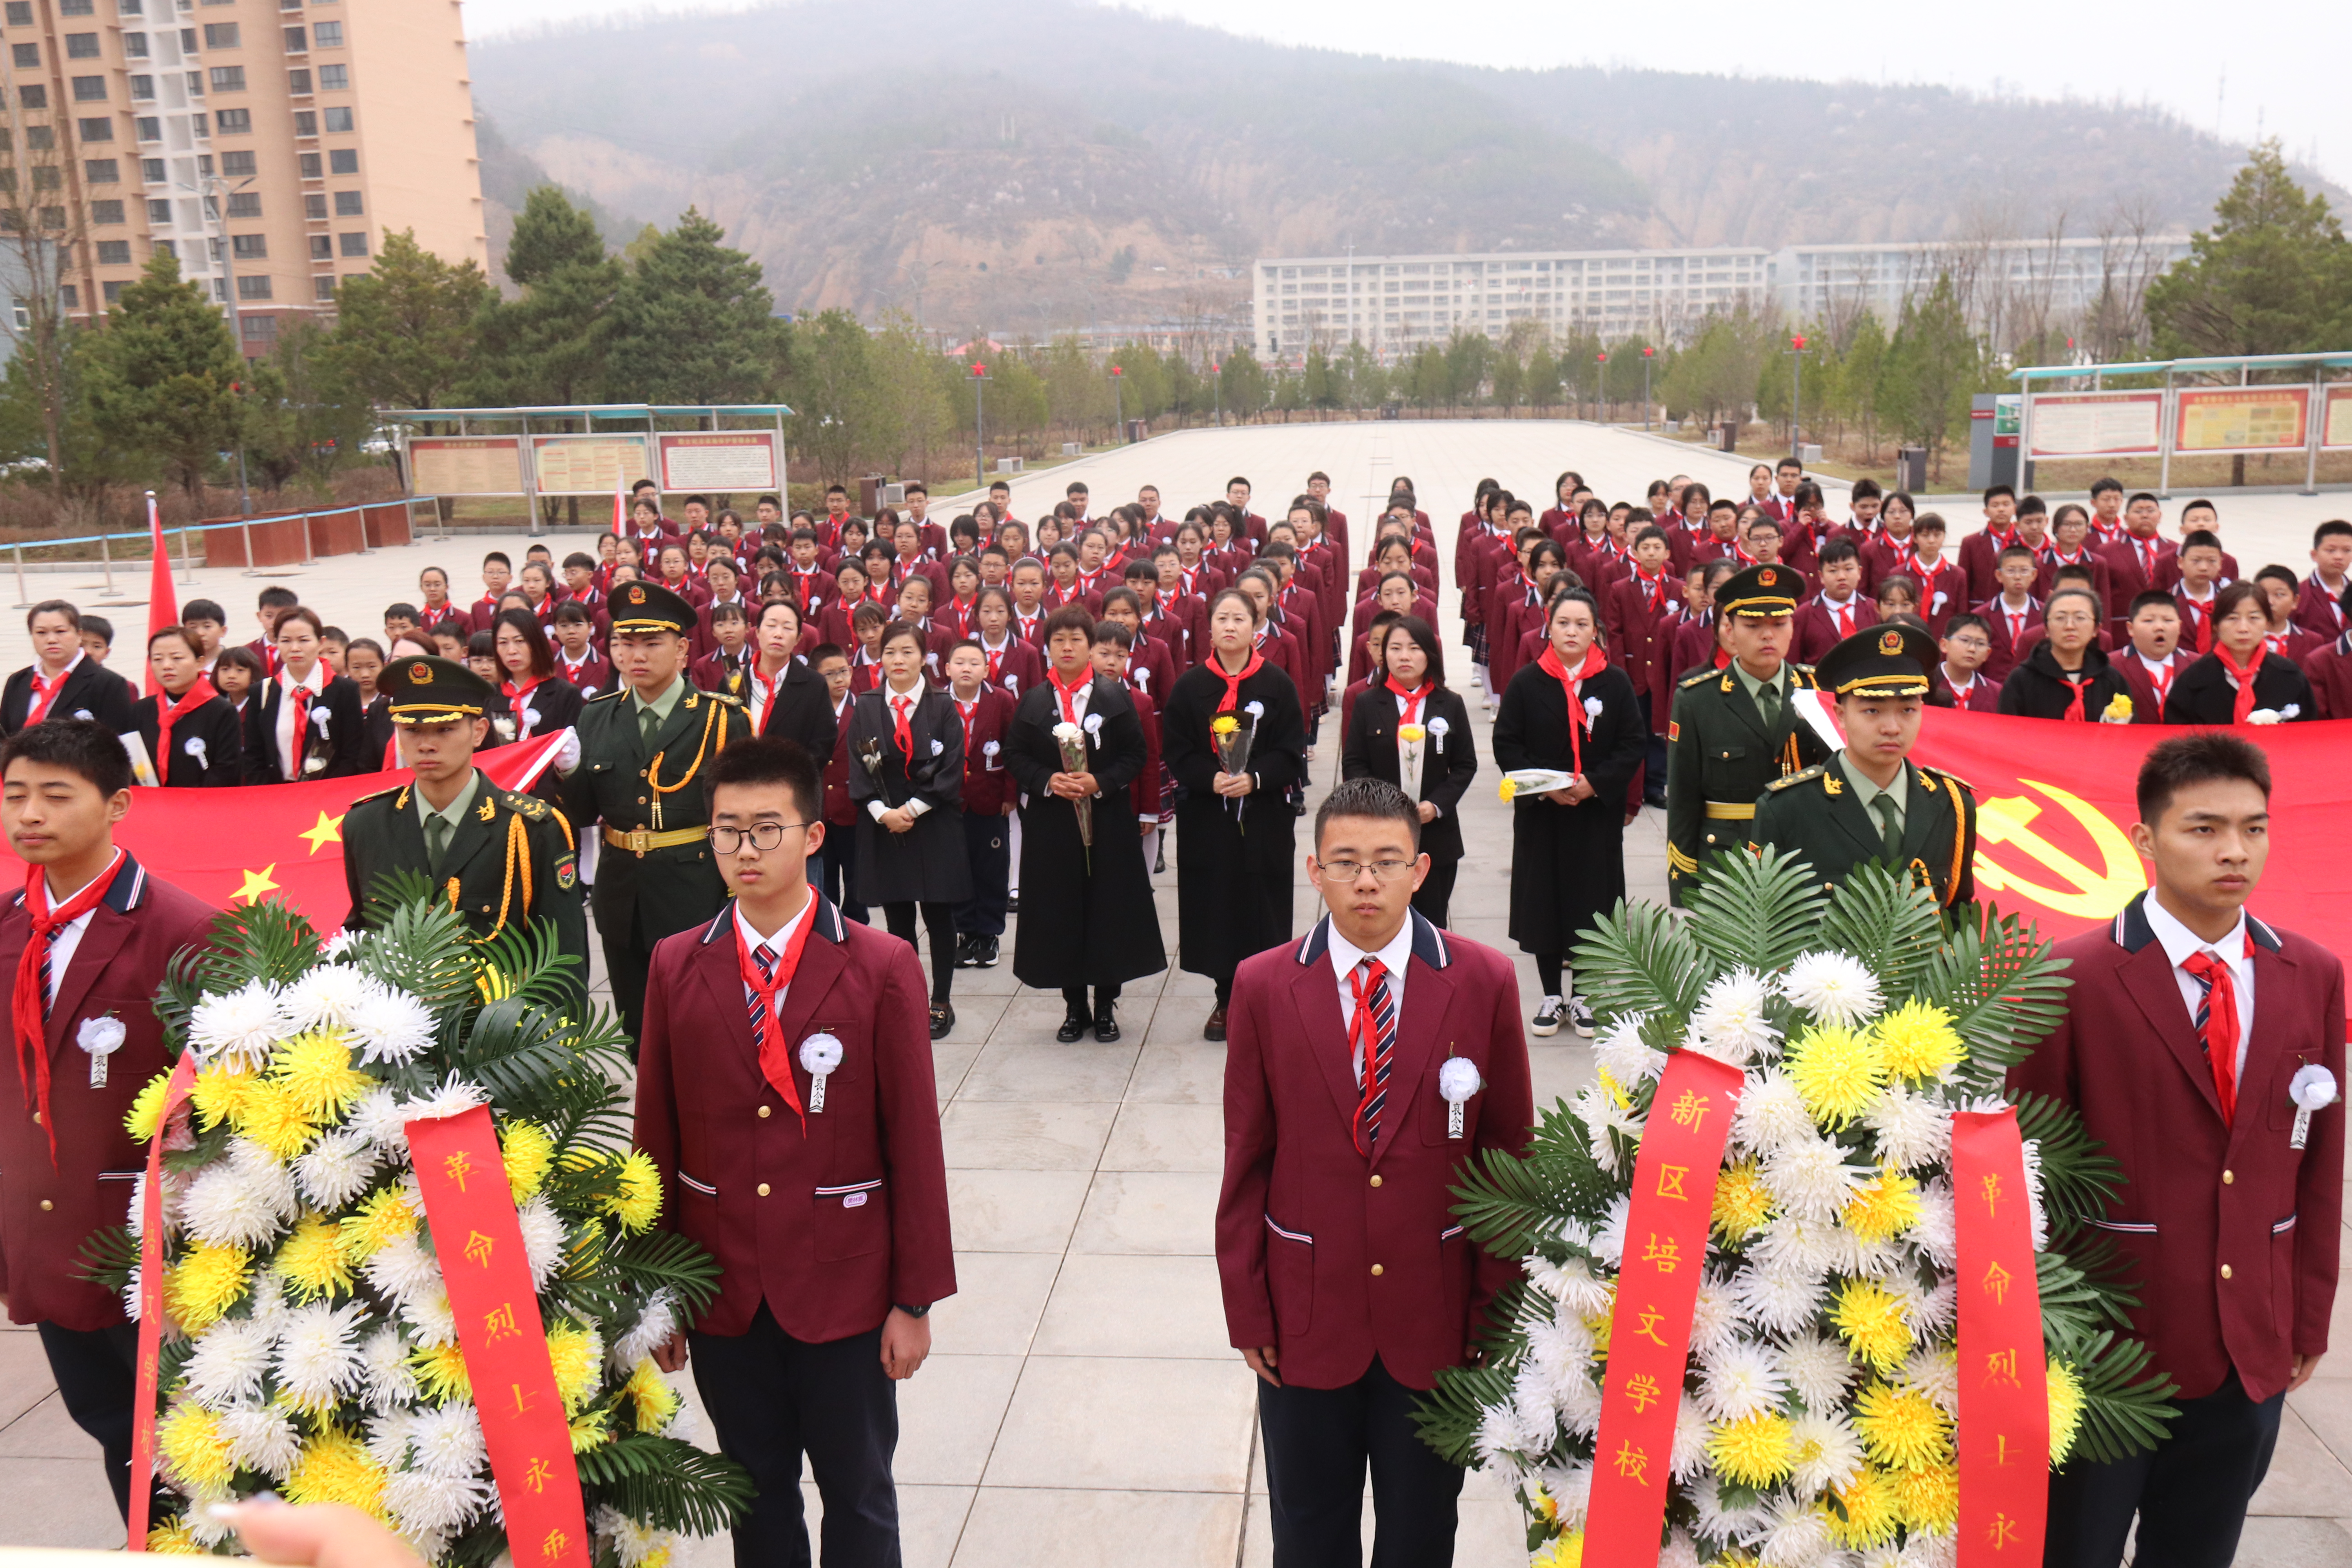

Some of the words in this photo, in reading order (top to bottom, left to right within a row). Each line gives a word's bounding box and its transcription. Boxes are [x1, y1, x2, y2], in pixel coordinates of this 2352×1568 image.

[95, 1055, 106, 1080] 哀念
[813, 1077, 824, 1104] 哀念
[1451, 1102, 1461, 1129] 哀念
[442, 1150, 573, 1568] 革命烈士永垂
[1613, 1089, 1710, 1486] 新区培文学校
[1980, 1173, 2024, 1550] 革命烈士永
